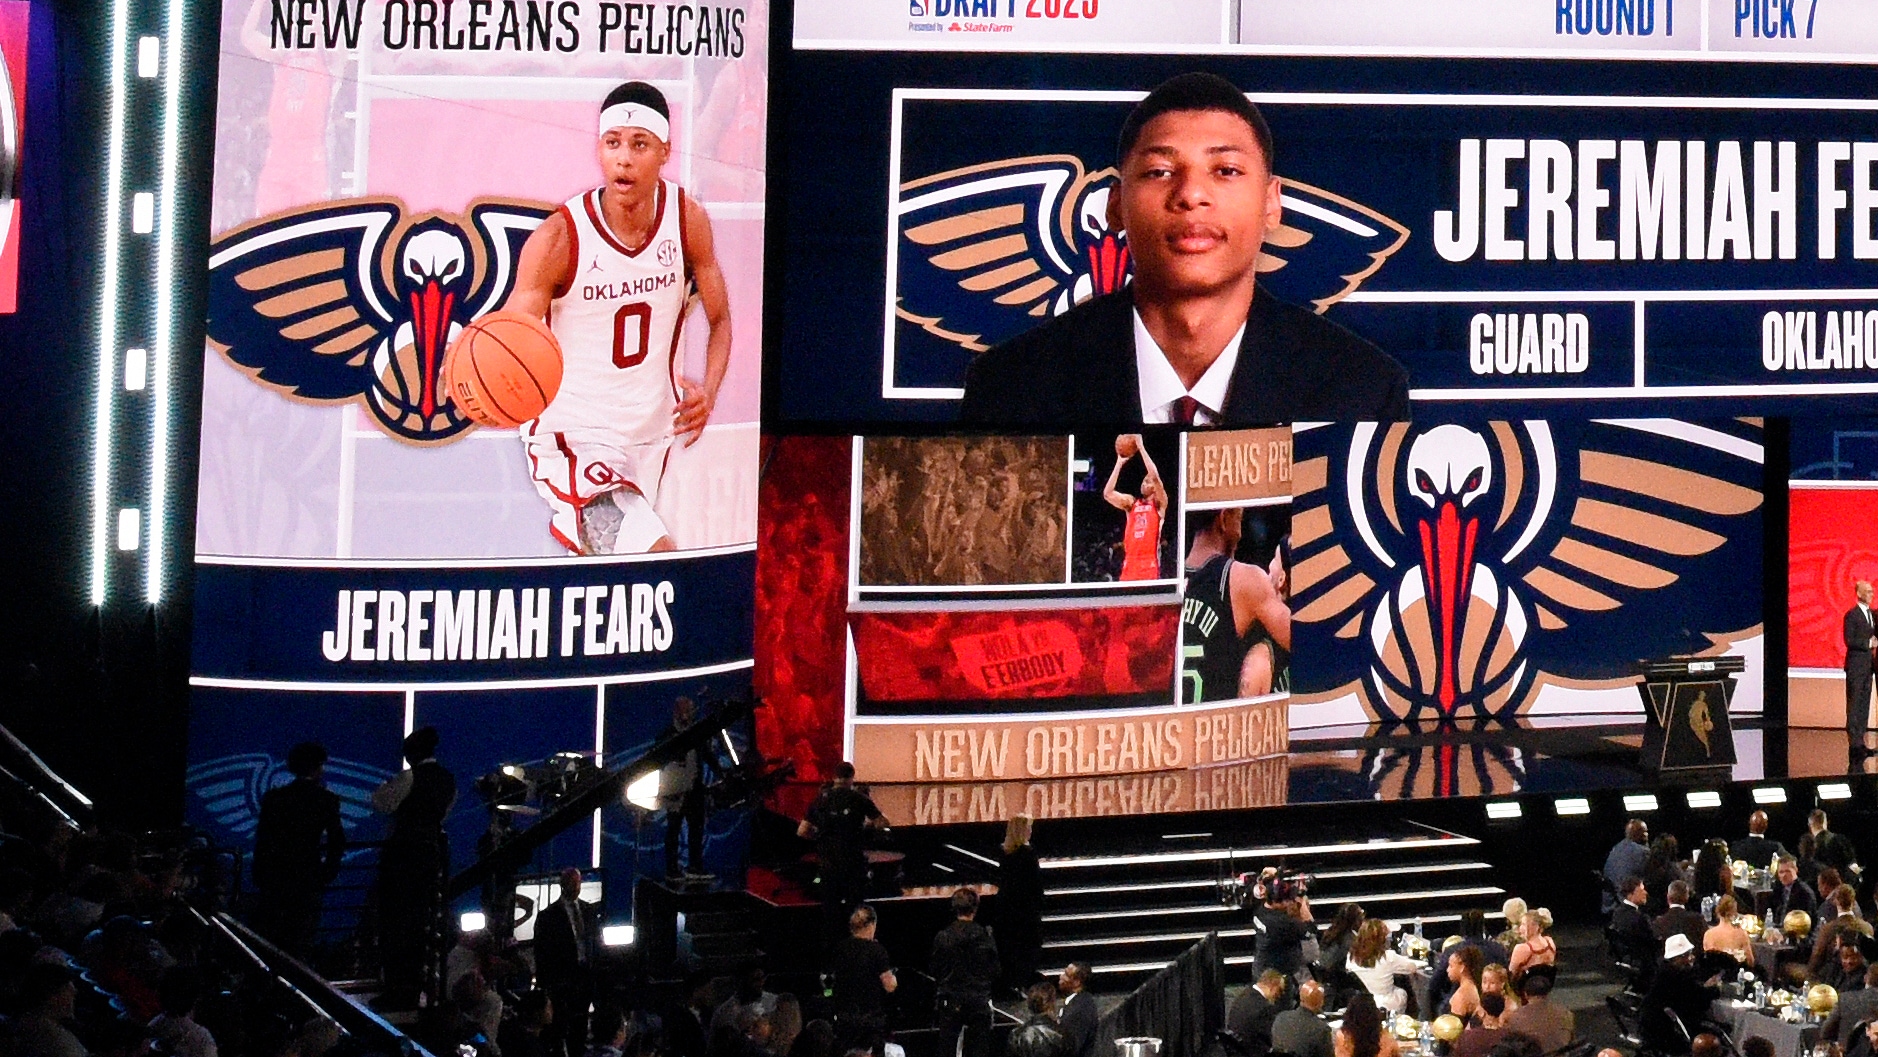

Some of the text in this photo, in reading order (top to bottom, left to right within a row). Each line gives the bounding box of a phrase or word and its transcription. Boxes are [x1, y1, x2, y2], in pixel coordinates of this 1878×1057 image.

[598, 2, 745, 58] PELICANS
[1433, 139, 1797, 262] JEREMIAH
[583, 272, 676, 301] OKLAHOMA
[612, 301, 653, 370] 0
[1469, 312, 1589, 374] GUARD
[1188, 441, 1261, 489] LEANS
[322, 581, 674, 662] JEREMIAH FEARS
[915, 728, 1011, 779] NEW
[1025, 718, 1182, 777] ORLEANS
